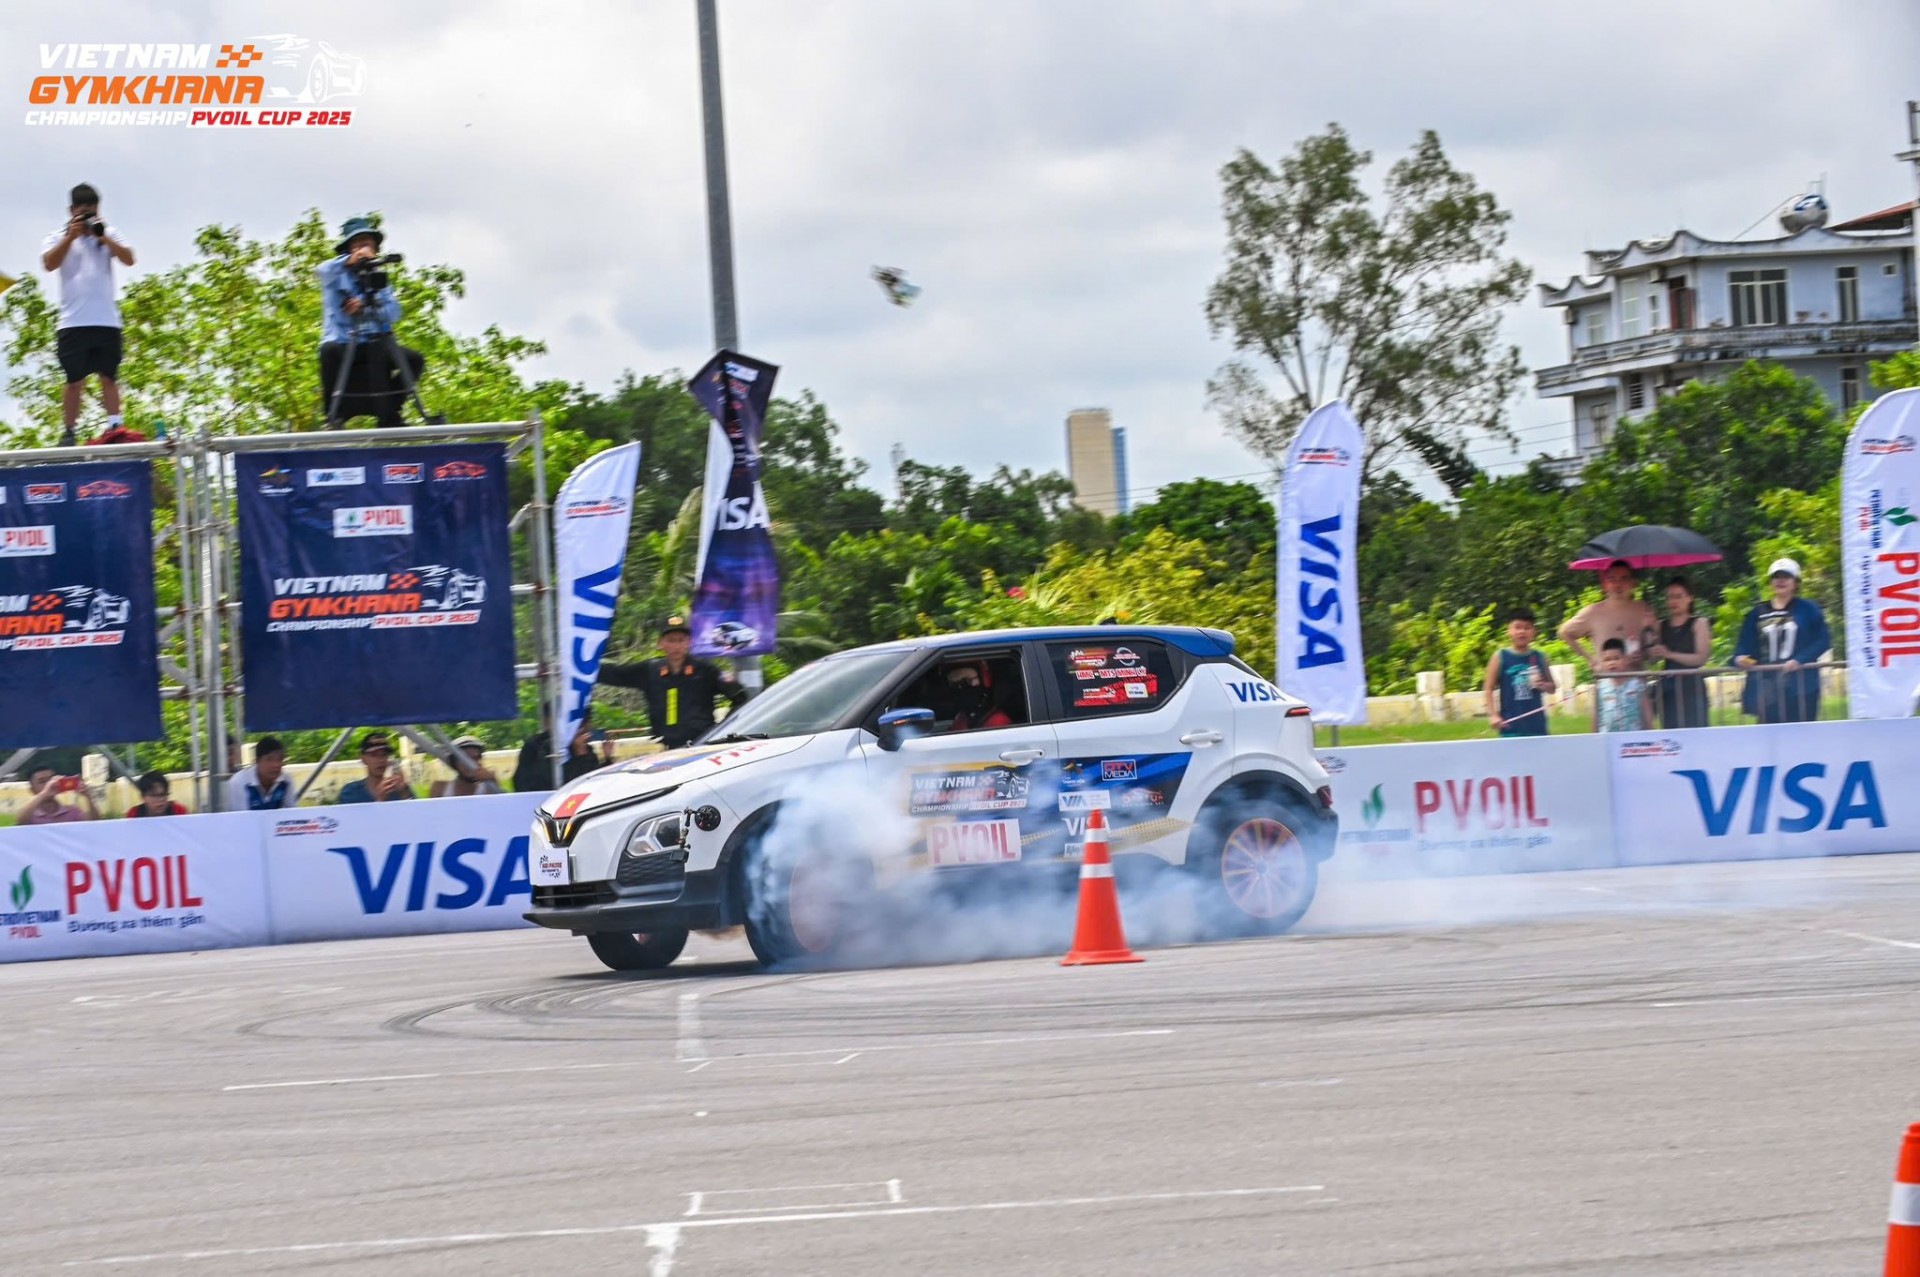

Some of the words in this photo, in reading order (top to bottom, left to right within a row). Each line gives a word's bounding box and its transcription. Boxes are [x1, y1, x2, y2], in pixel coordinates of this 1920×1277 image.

[718, 480, 770, 531] ISA
[269, 592, 422, 619] GYMKHANA
[273, 573, 388, 596] VIETNAM
[1297, 515, 1345, 670] VISA
[1877, 552, 1920, 668] PVOIL
[1225, 681, 1287, 702] VISA
[915, 775, 976, 790] VIETNAM
[1414, 775, 1549, 834] PVOIL
[1669, 760, 1888, 837] VISA
[932, 823, 1016, 864] PVOIL
[66, 854, 204, 915] PVOIL
[326, 835, 530, 915] VISA
